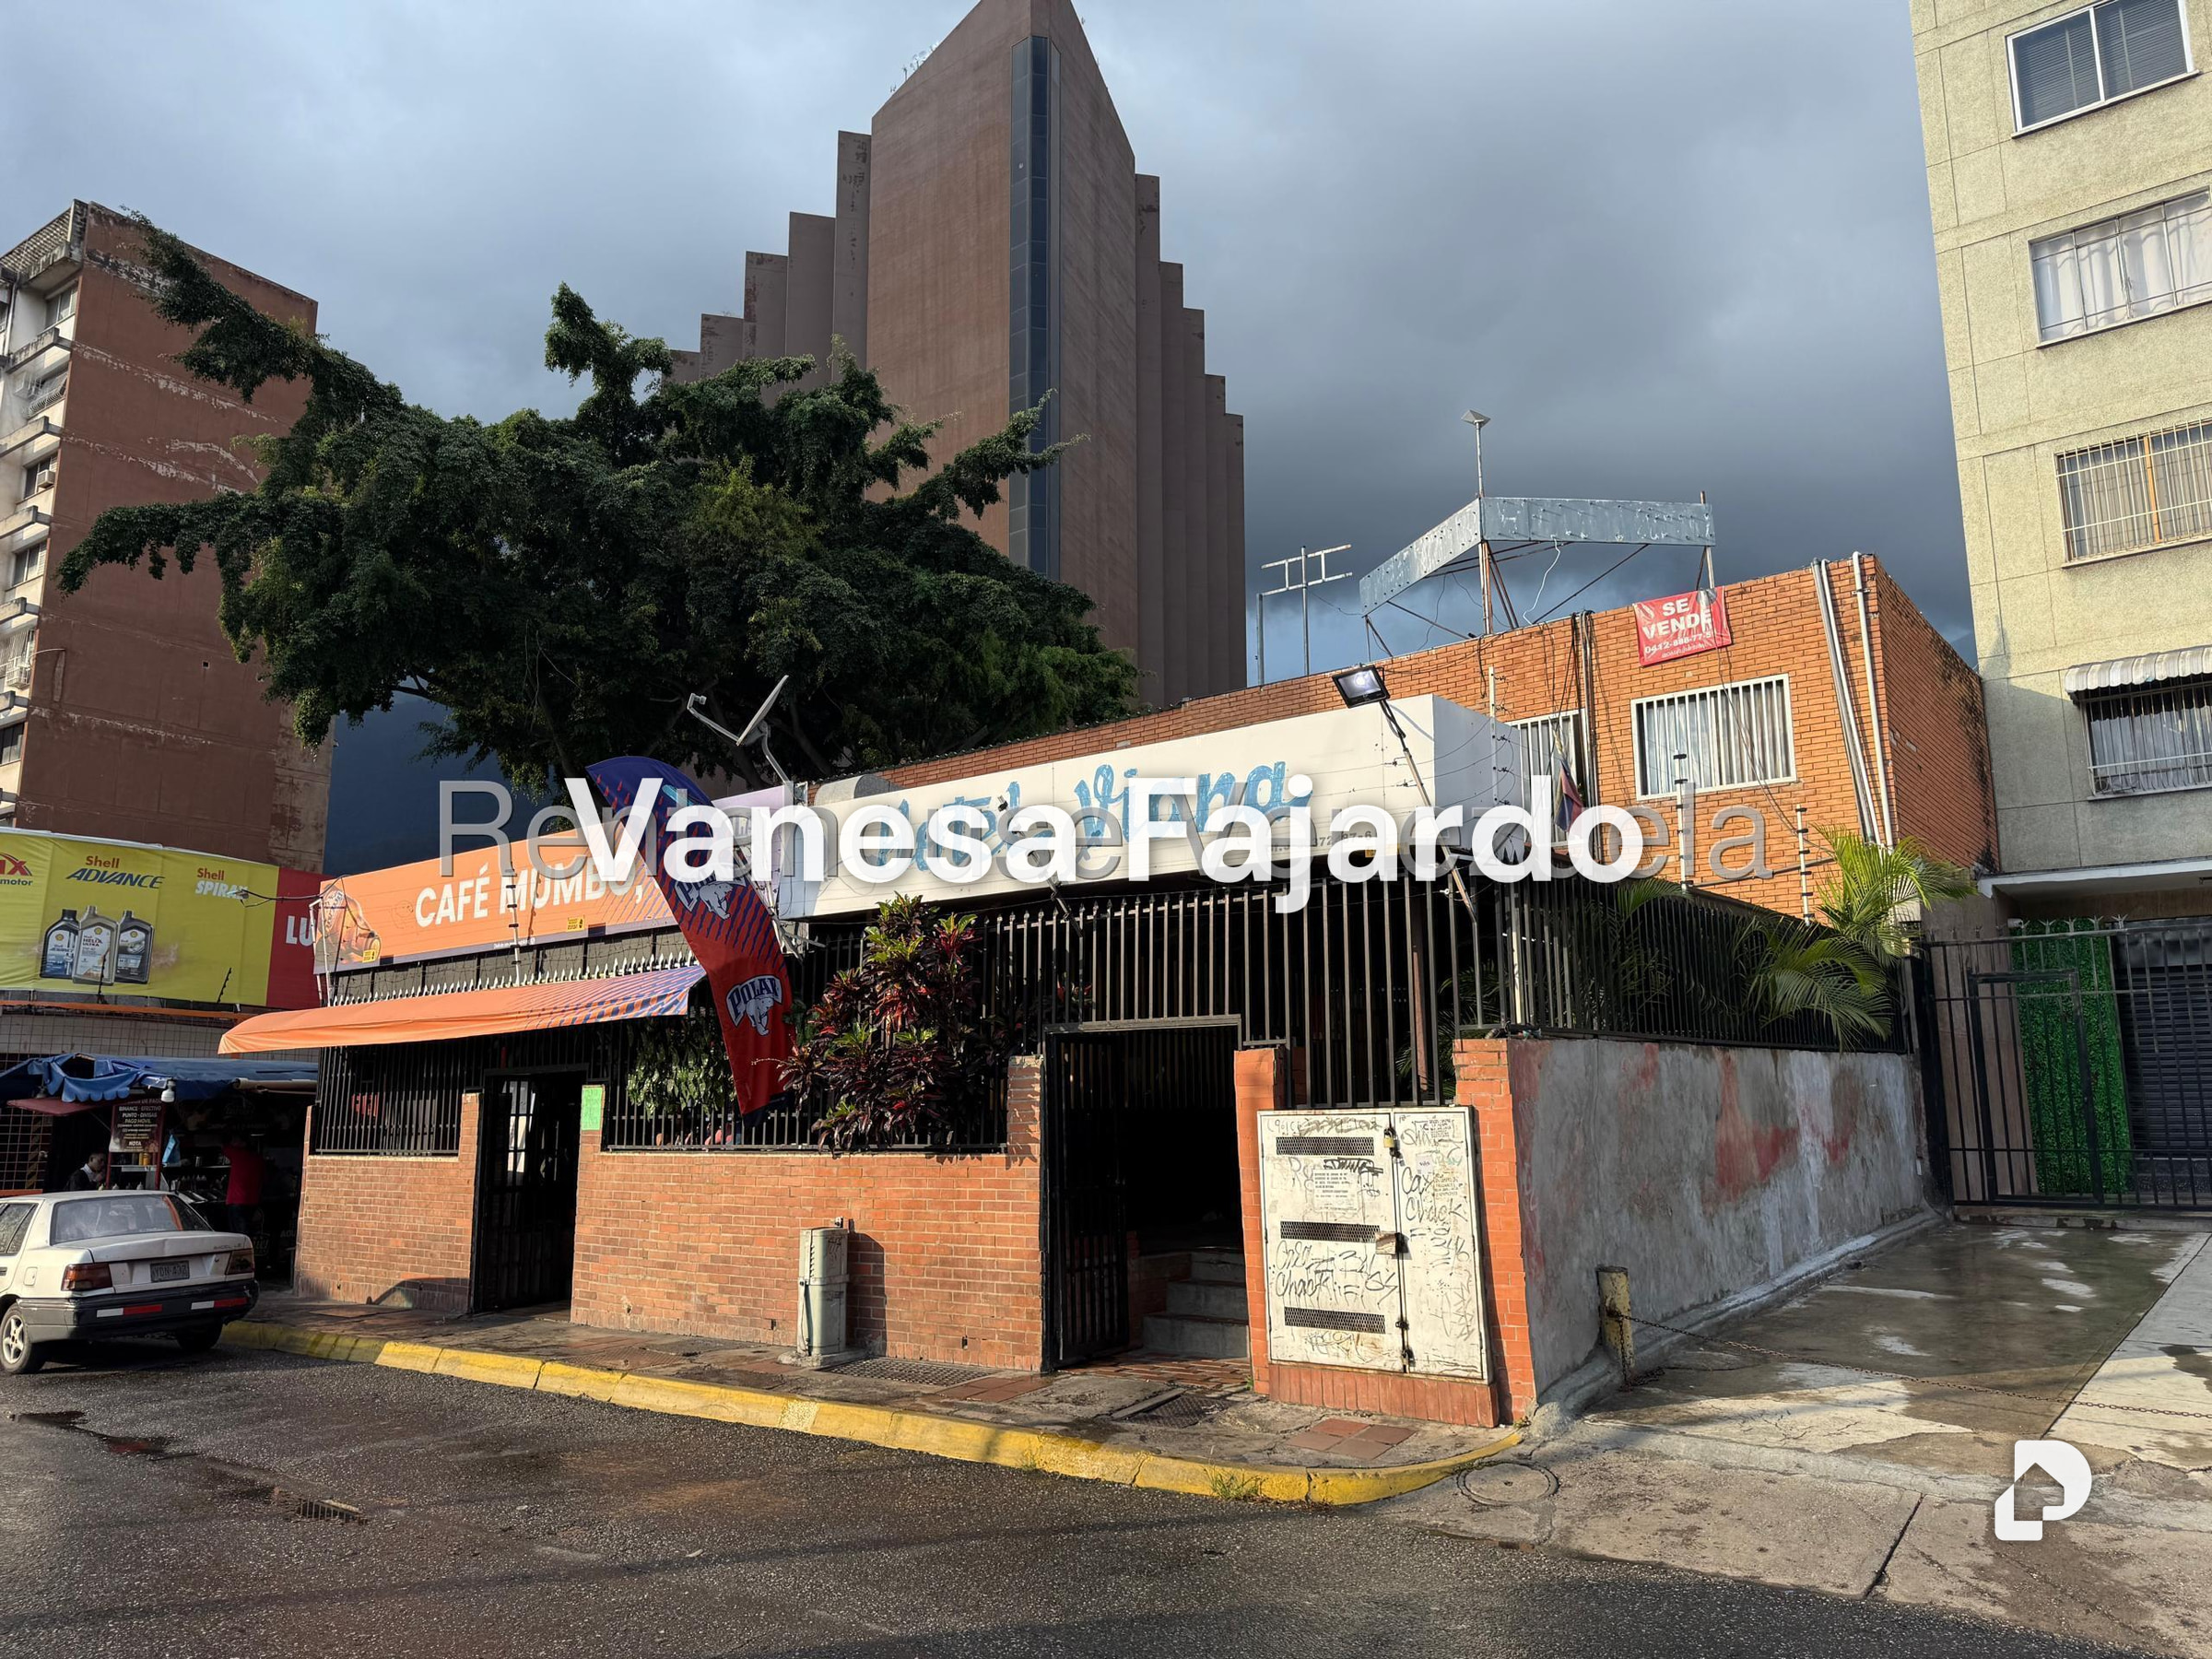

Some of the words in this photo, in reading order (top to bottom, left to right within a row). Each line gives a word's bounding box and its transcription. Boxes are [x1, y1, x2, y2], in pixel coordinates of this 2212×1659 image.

[1662, 597, 1690, 618] SE
[1641, 607, 1712, 640] VENDE
[85, 855, 120, 868] Shell
[65, 867, 165, 889] ADVANCE
[196, 867, 225, 881] Shell
[415, 862, 491, 928] CAFÉ
[728, 977, 779, 1020] POLAR
